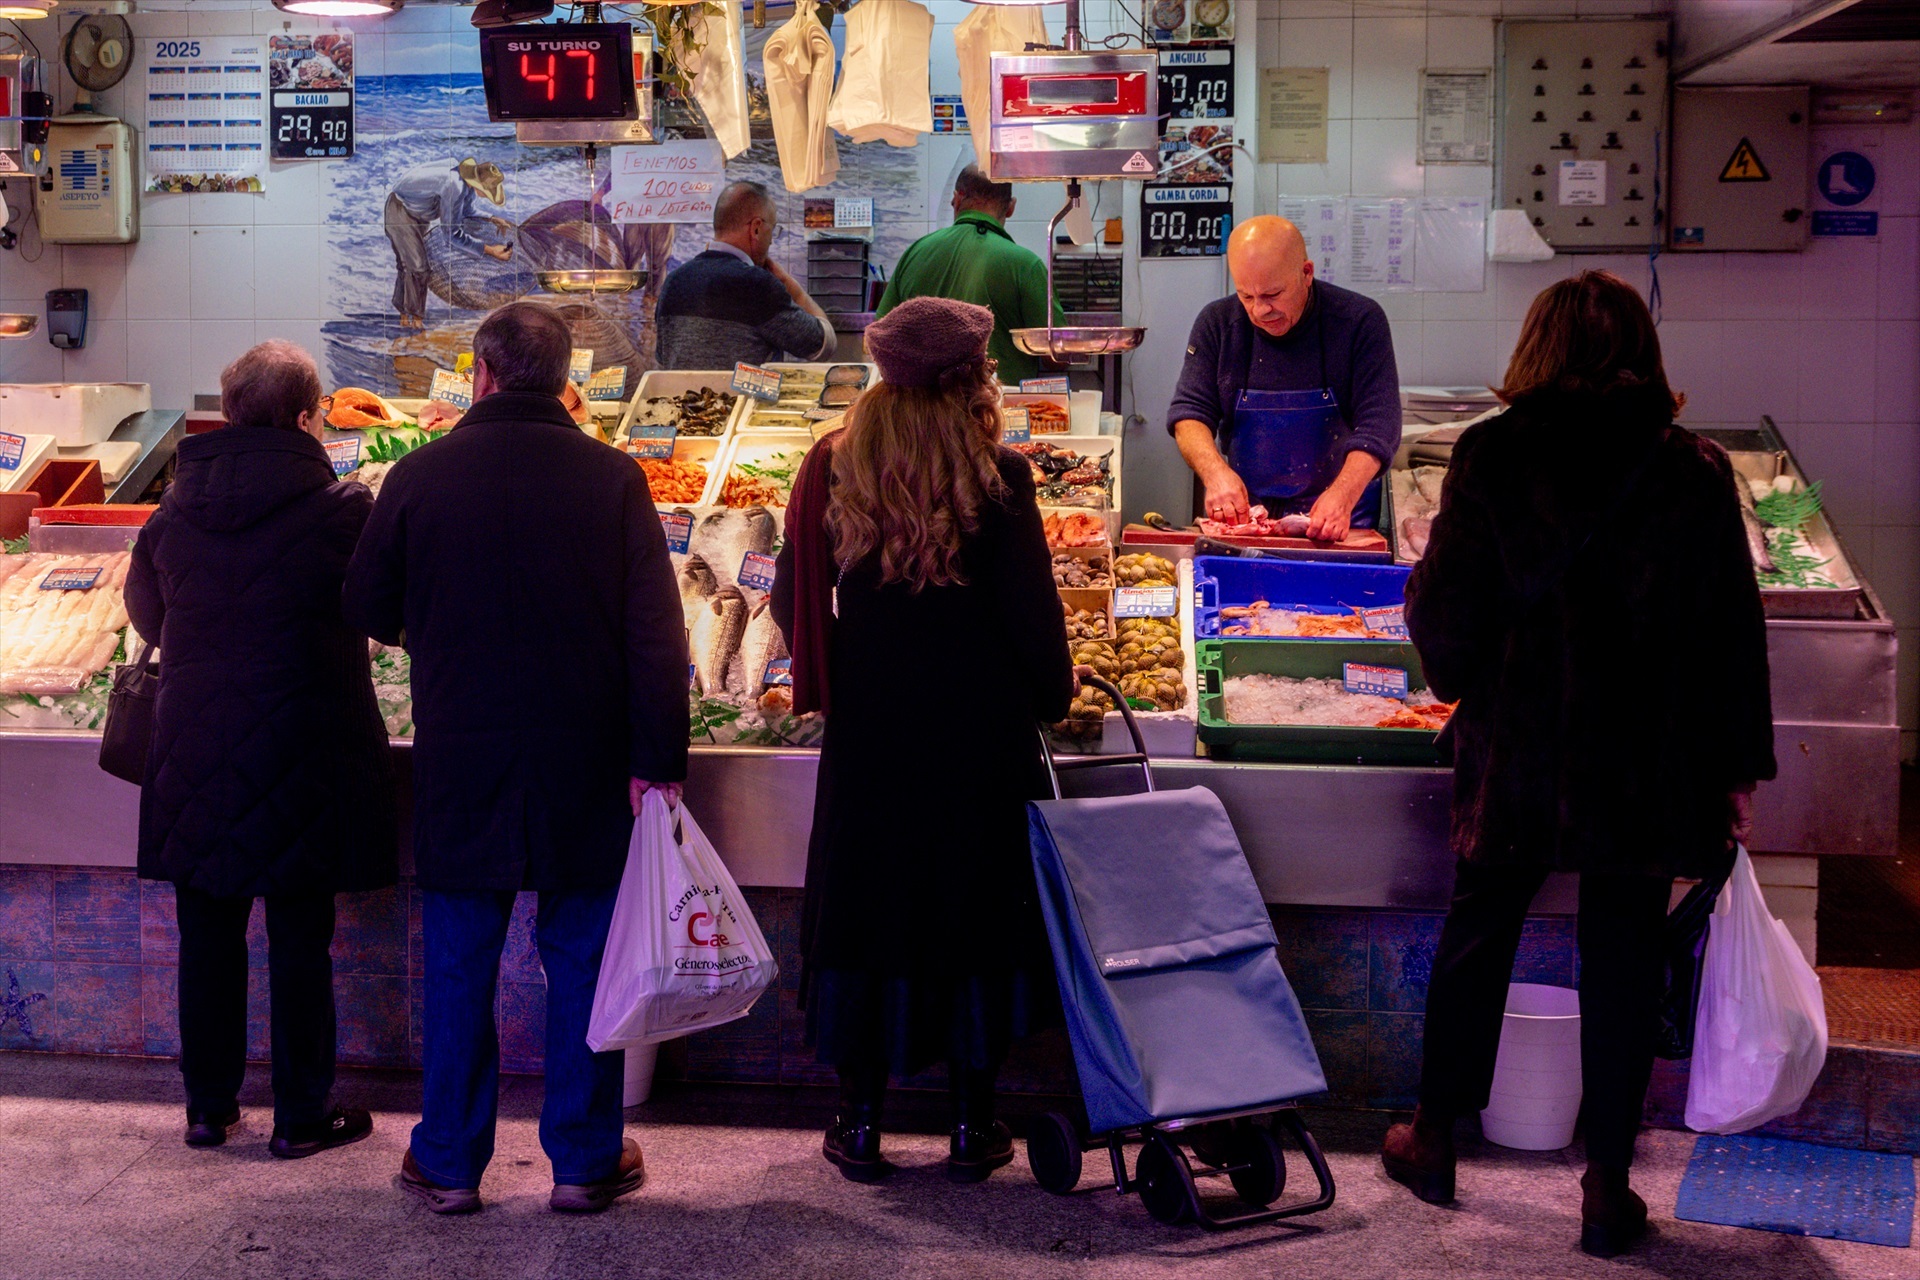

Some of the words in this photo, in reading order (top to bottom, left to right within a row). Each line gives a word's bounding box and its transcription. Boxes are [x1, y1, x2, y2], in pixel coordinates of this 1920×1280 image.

[156, 42, 201, 58] 2025
[507, 42, 531, 52] SU
[537, 41, 601, 51] TURNO
[1169, 52, 1207, 64] ANGULAS
[521, 50, 595, 101] 47
[295, 94, 329, 105] BACALAO
[279, 115, 347, 143] 29,90
[328, 146, 347, 156] KILO
[623, 151, 697, 170] TENEMOS
[643, 178, 677, 197] 100
[60, 192, 99, 201] ASEPEYO
[1155, 189, 1186, 201] GAMBA
[1189, 189, 1218, 200] GORDA
[613, 201, 634, 219] EN
[638, 203, 652, 217] LA
[1111, 958, 1140, 967] ROLSER
